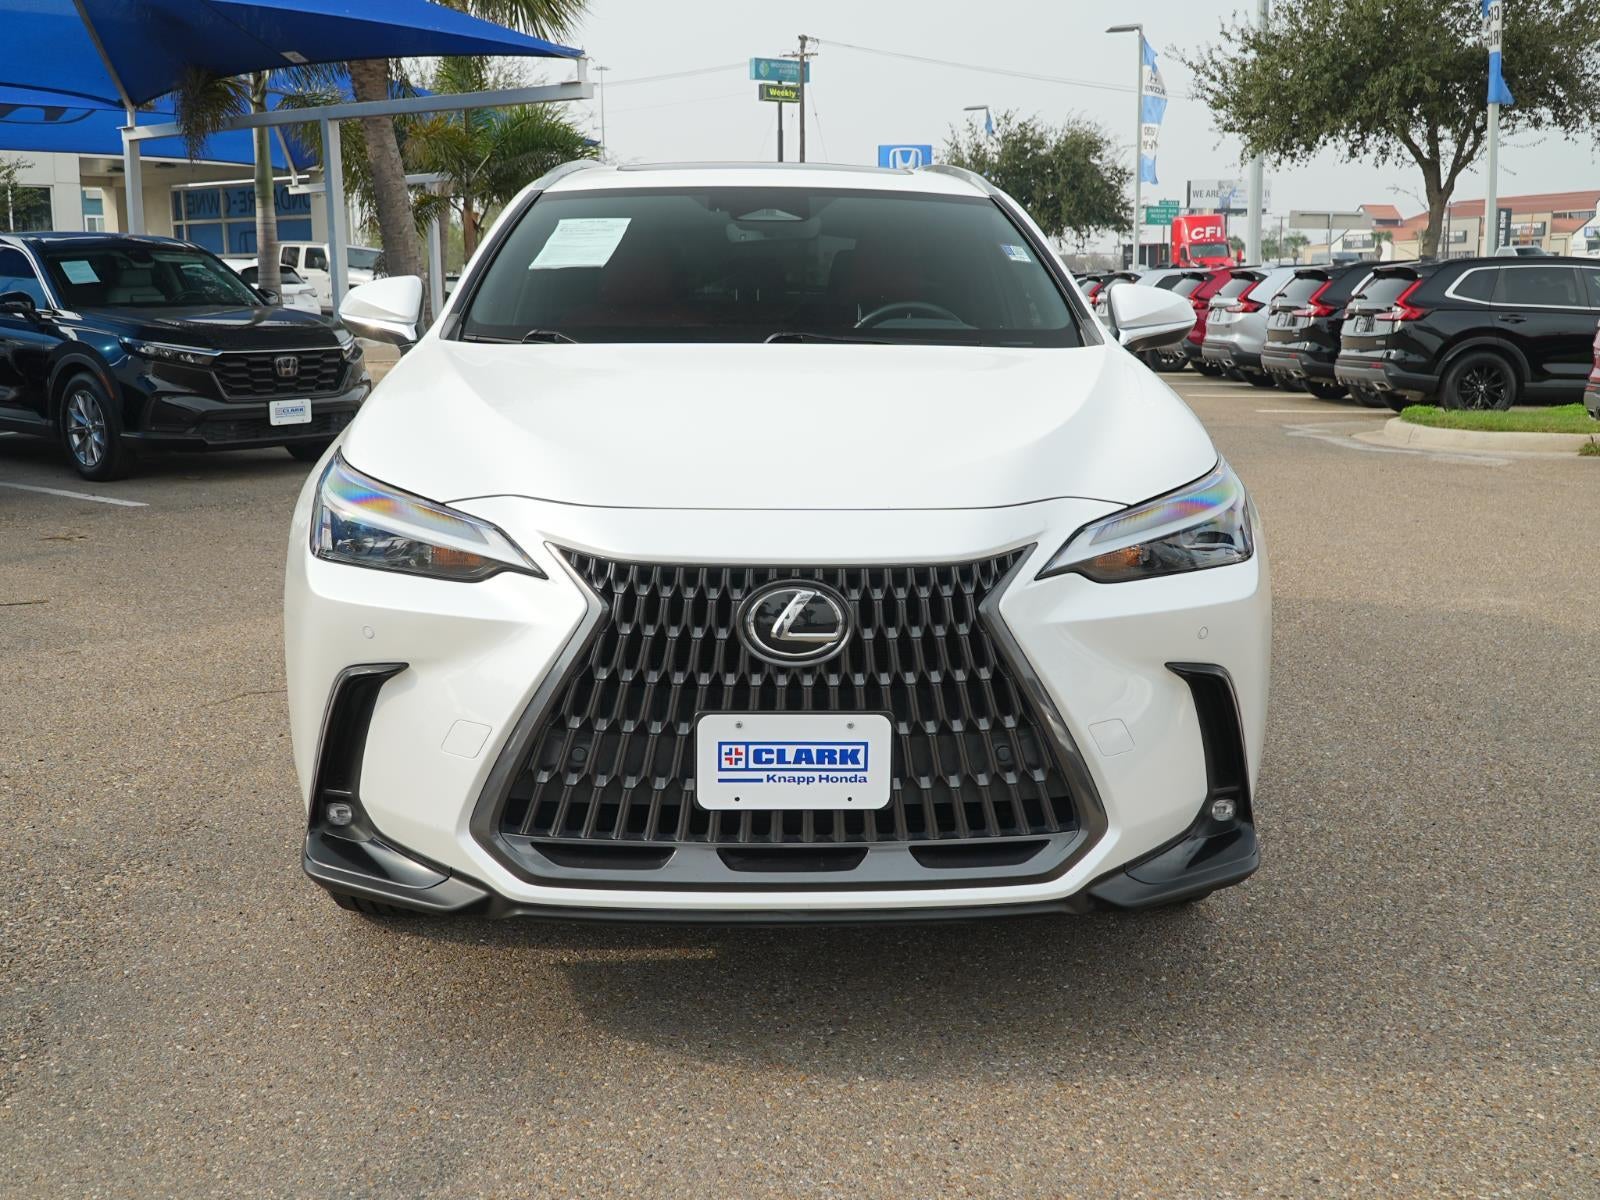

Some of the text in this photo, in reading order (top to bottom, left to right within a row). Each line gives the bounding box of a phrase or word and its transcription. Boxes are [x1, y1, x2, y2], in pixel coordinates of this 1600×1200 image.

[769, 87, 796, 99] Weekly
[1192, 189, 1203, 198] WE
[1191, 226, 1222, 240] CFI
[752, 748, 861, 765] CLARK
[766, 774, 868, 785] Knapp Honda
